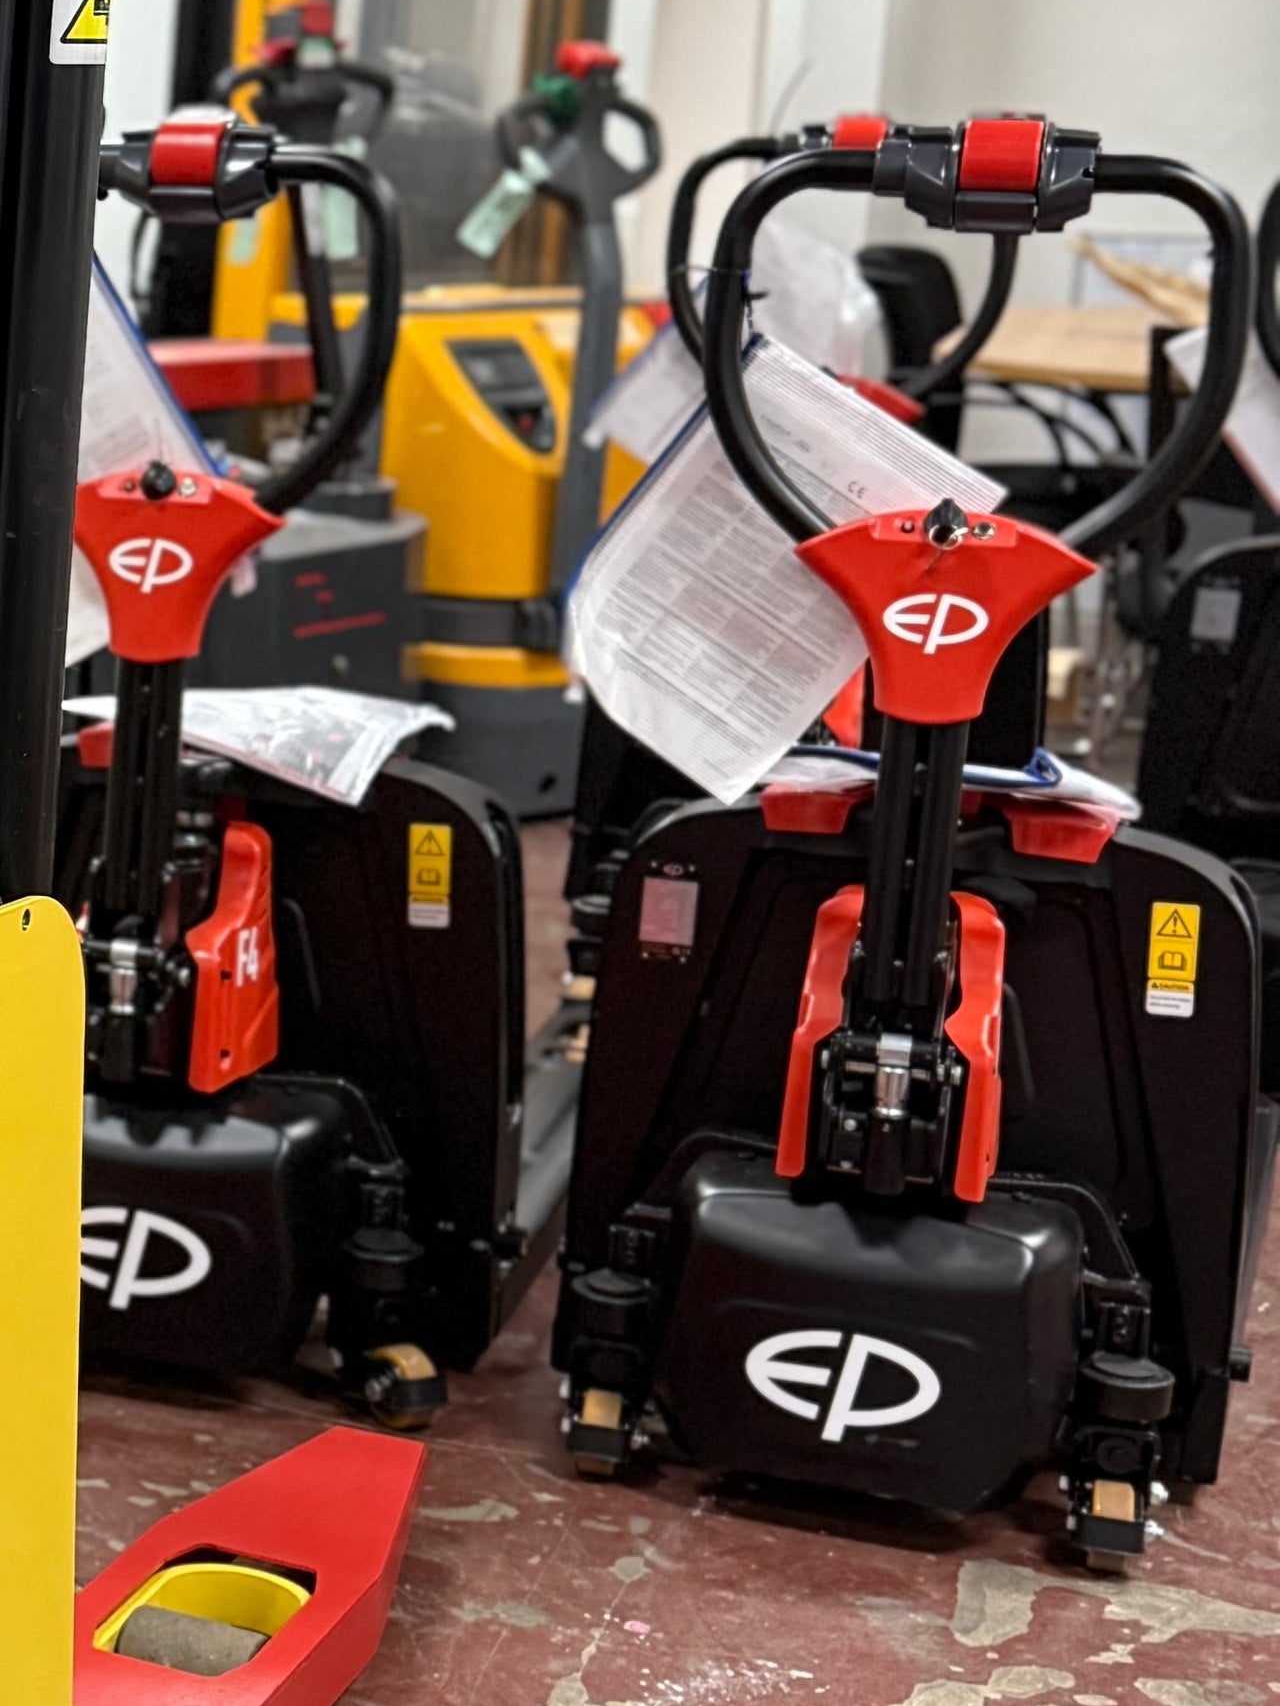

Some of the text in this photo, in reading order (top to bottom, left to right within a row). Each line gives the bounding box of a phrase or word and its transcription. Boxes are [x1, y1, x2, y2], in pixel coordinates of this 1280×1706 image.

[109, 538, 193, 593] EP
[883, 594, 989, 654] EP
[745, 1329, 941, 1442] EP
